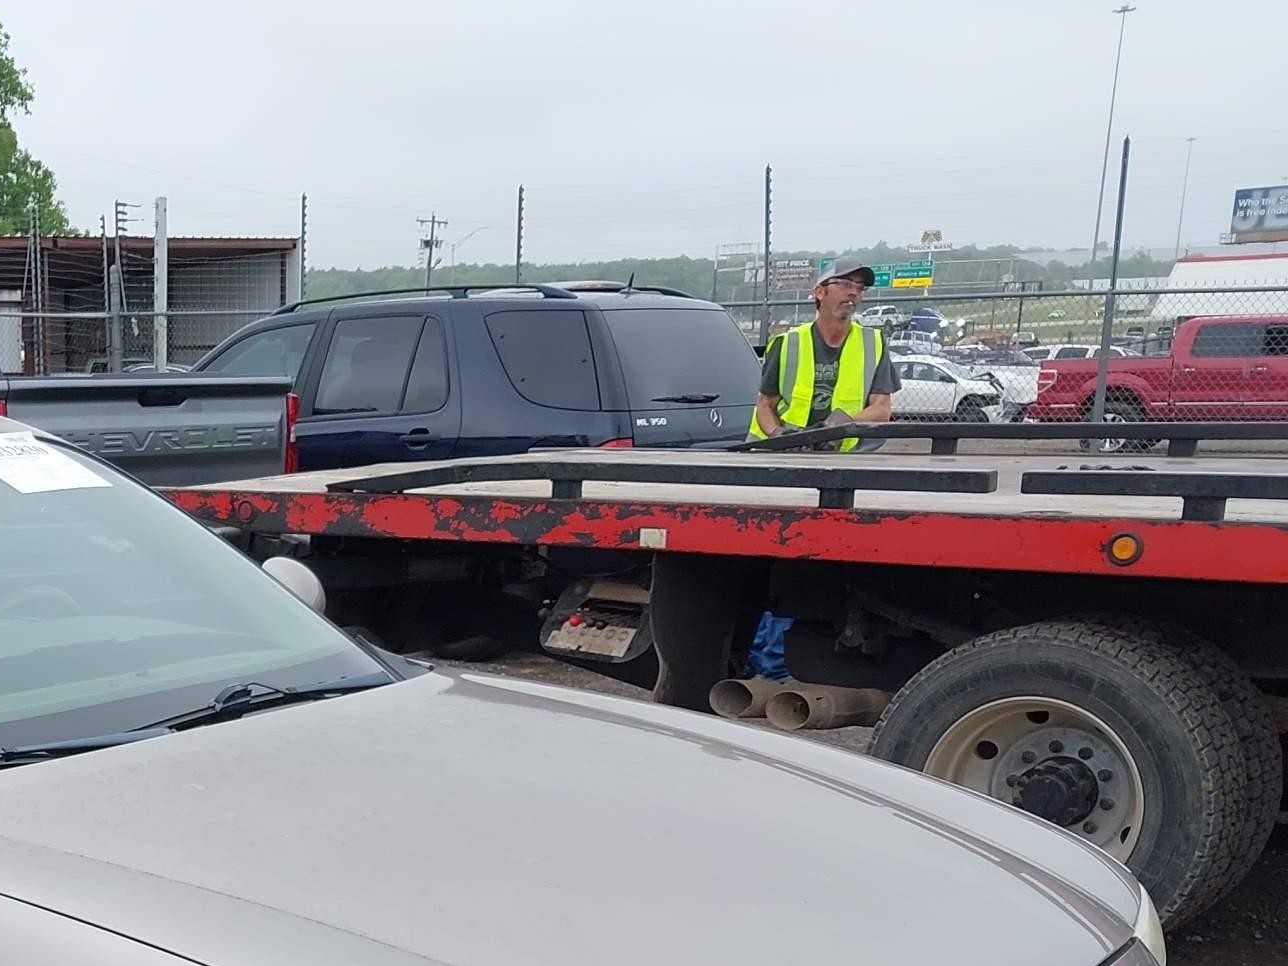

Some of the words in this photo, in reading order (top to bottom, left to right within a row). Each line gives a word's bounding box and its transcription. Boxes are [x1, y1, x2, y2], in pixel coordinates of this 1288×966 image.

[1238, 198, 1260, 207] Who
[1246, 207, 1266, 217] free
[650, 417, 668, 426] 350
